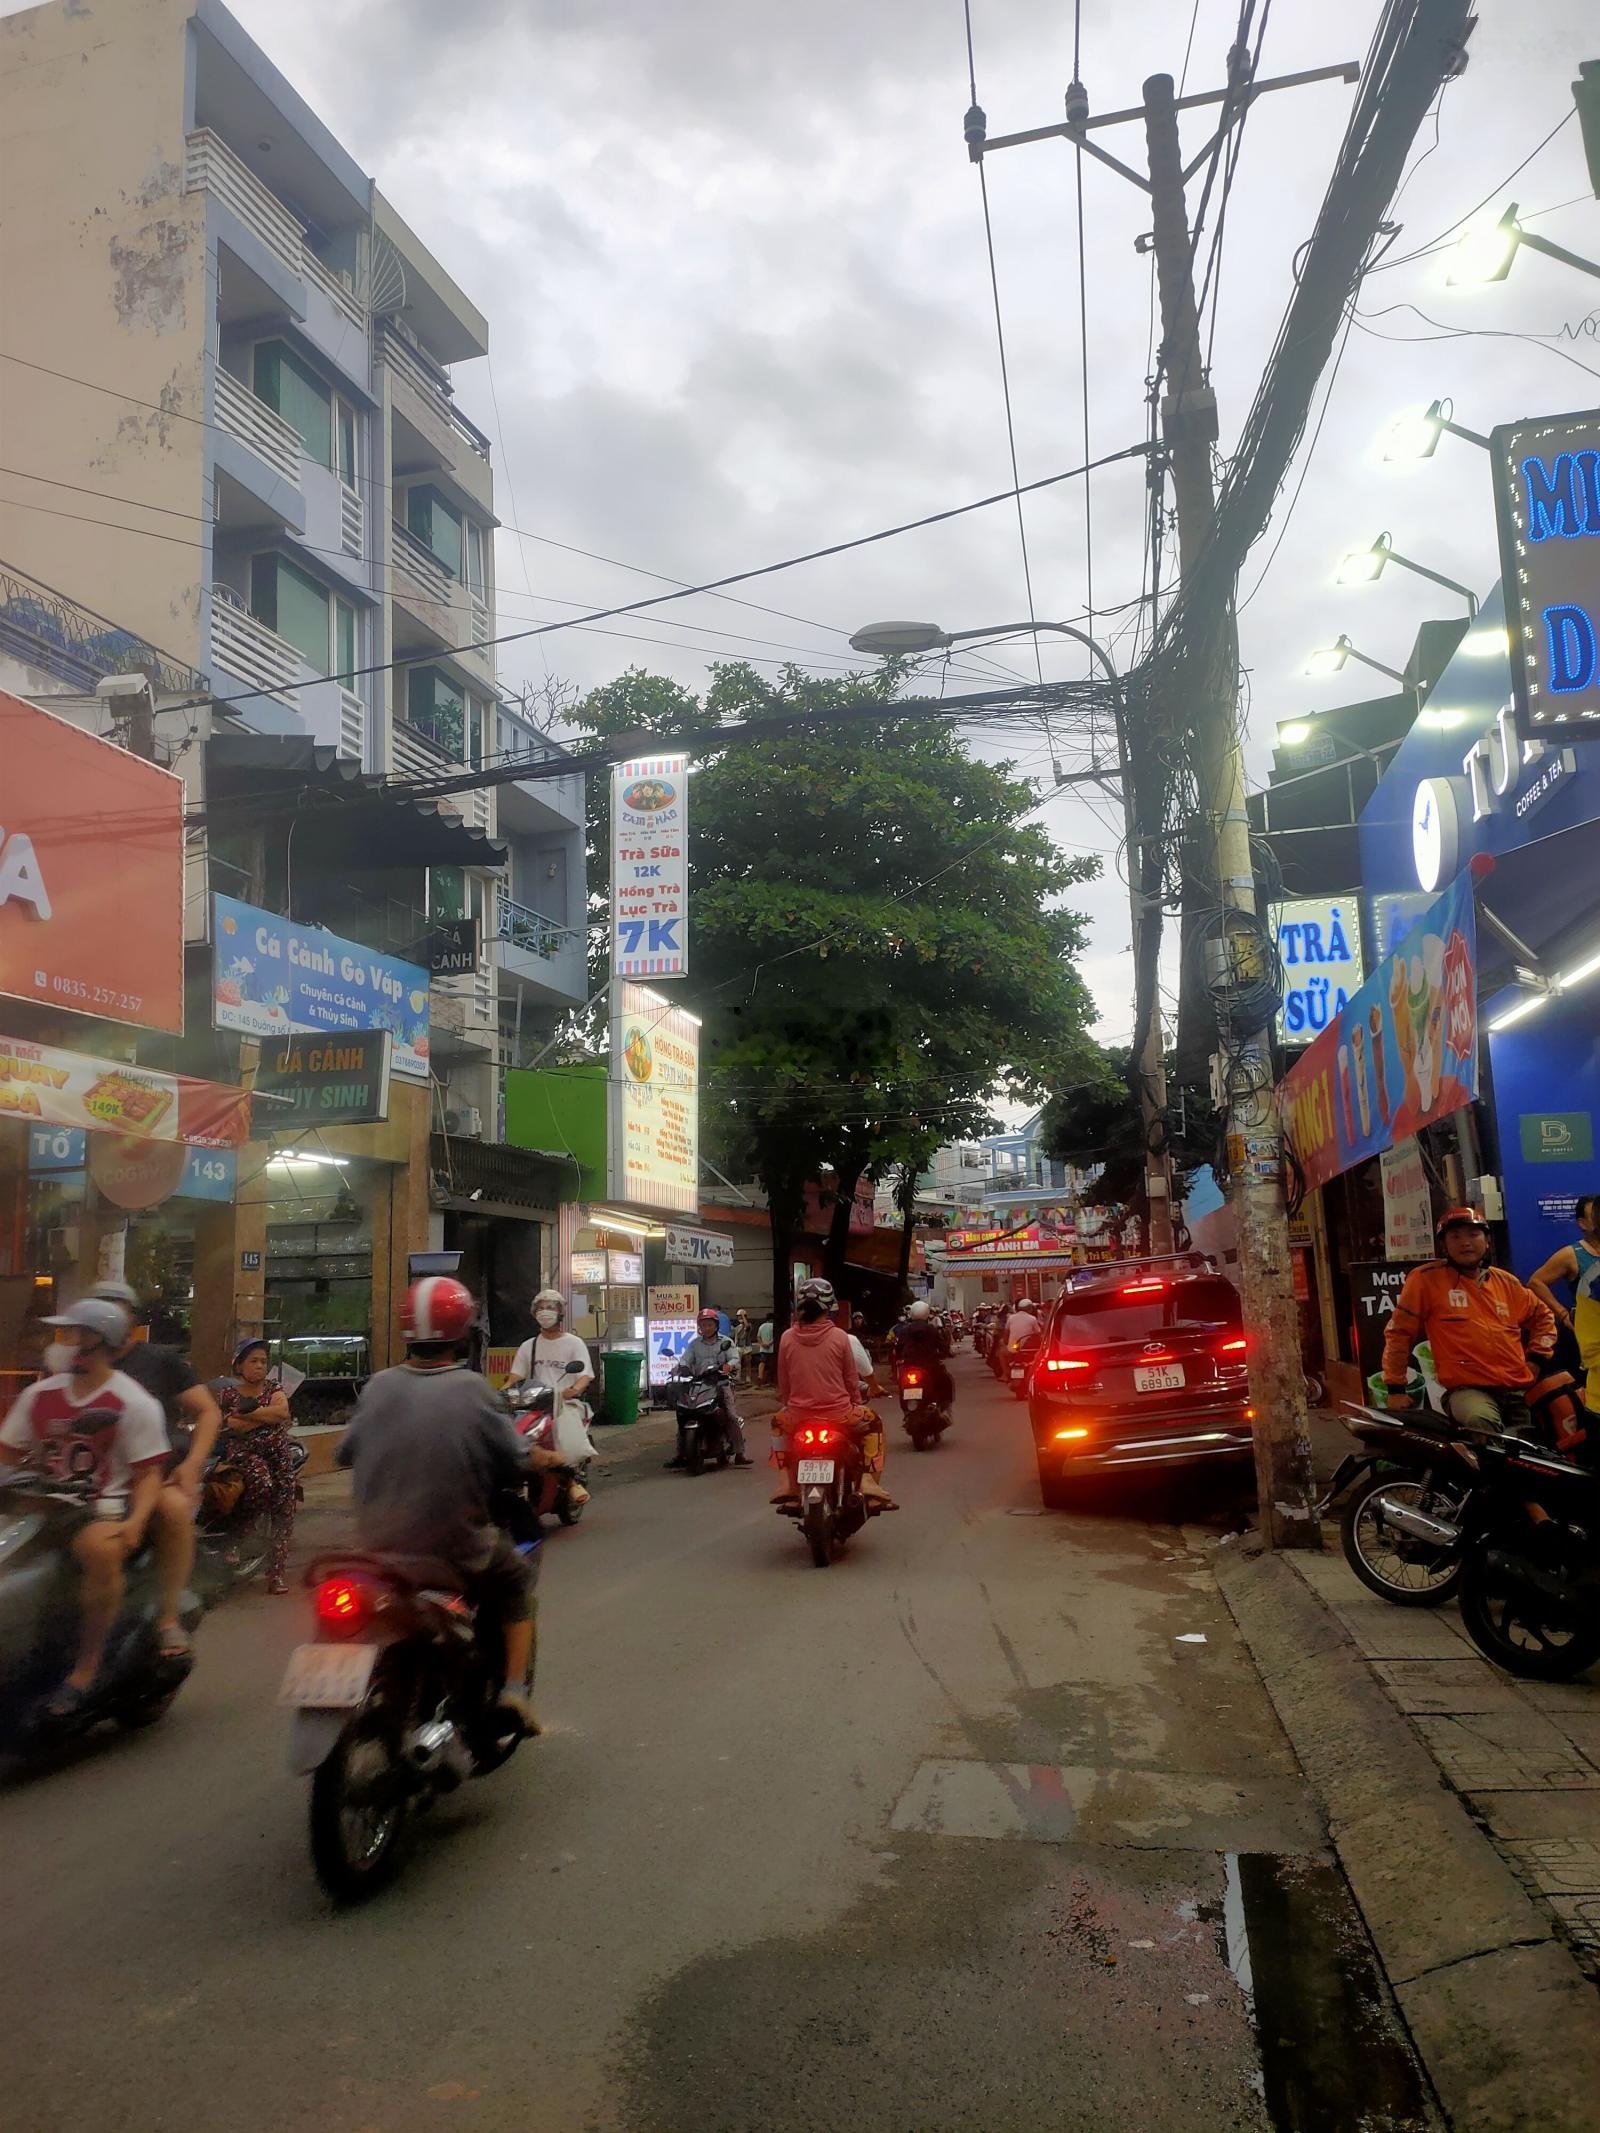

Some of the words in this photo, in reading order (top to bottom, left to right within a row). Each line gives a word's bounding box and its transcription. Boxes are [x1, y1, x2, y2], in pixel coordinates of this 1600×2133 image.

[1516, 781, 1541, 817] COFFEE
[1542, 774, 1548, 790] &
[1548, 759, 1563, 782] TEA
[619, 848, 645, 861] Trà
[650, 845, 680, 859] Sữa
[634, 864, 661, 878] 12K
[619, 885, 655, 898] Hồng
[659, 883, 680, 895] Trà
[620, 904, 648, 917] Lục
[652, 900, 678, 913] Trà
[618, 918, 681, 954] 7K
[1281, 908, 1350, 964] TRÀ
[255, 928, 280, 959] Cá
[287, 938, 335, 976] Cảnh
[340, 957, 365, 986] Gò
[369, 965, 403, 1004] Vấp
[53, 975, 142, 1012] 0835.257.257
[300, 983, 333, 1004] Chuyên
[334, 991, 345, 1005] Cá
[346, 996, 367, 1013] Cảnh
[309, 1005, 316, 1016] &
[340, 1012, 358, 1028] Sinh
[308, 1040, 364, 1072] CẢNH
[91, 1100, 119, 1115] 149K
[321, 1084, 369, 1108] SINH
[191, 1157, 226, 1181] 143
[690, 1237, 710, 1260] 7K
[996, 1241, 1021, 1252] ANH
[684, 1294, 695, 1313] 1
[1360, 1289, 1401, 1316] TÀ
[653, 1331, 695, 1355] 7K
[1147, 1366, 1169, 1378] 51K
